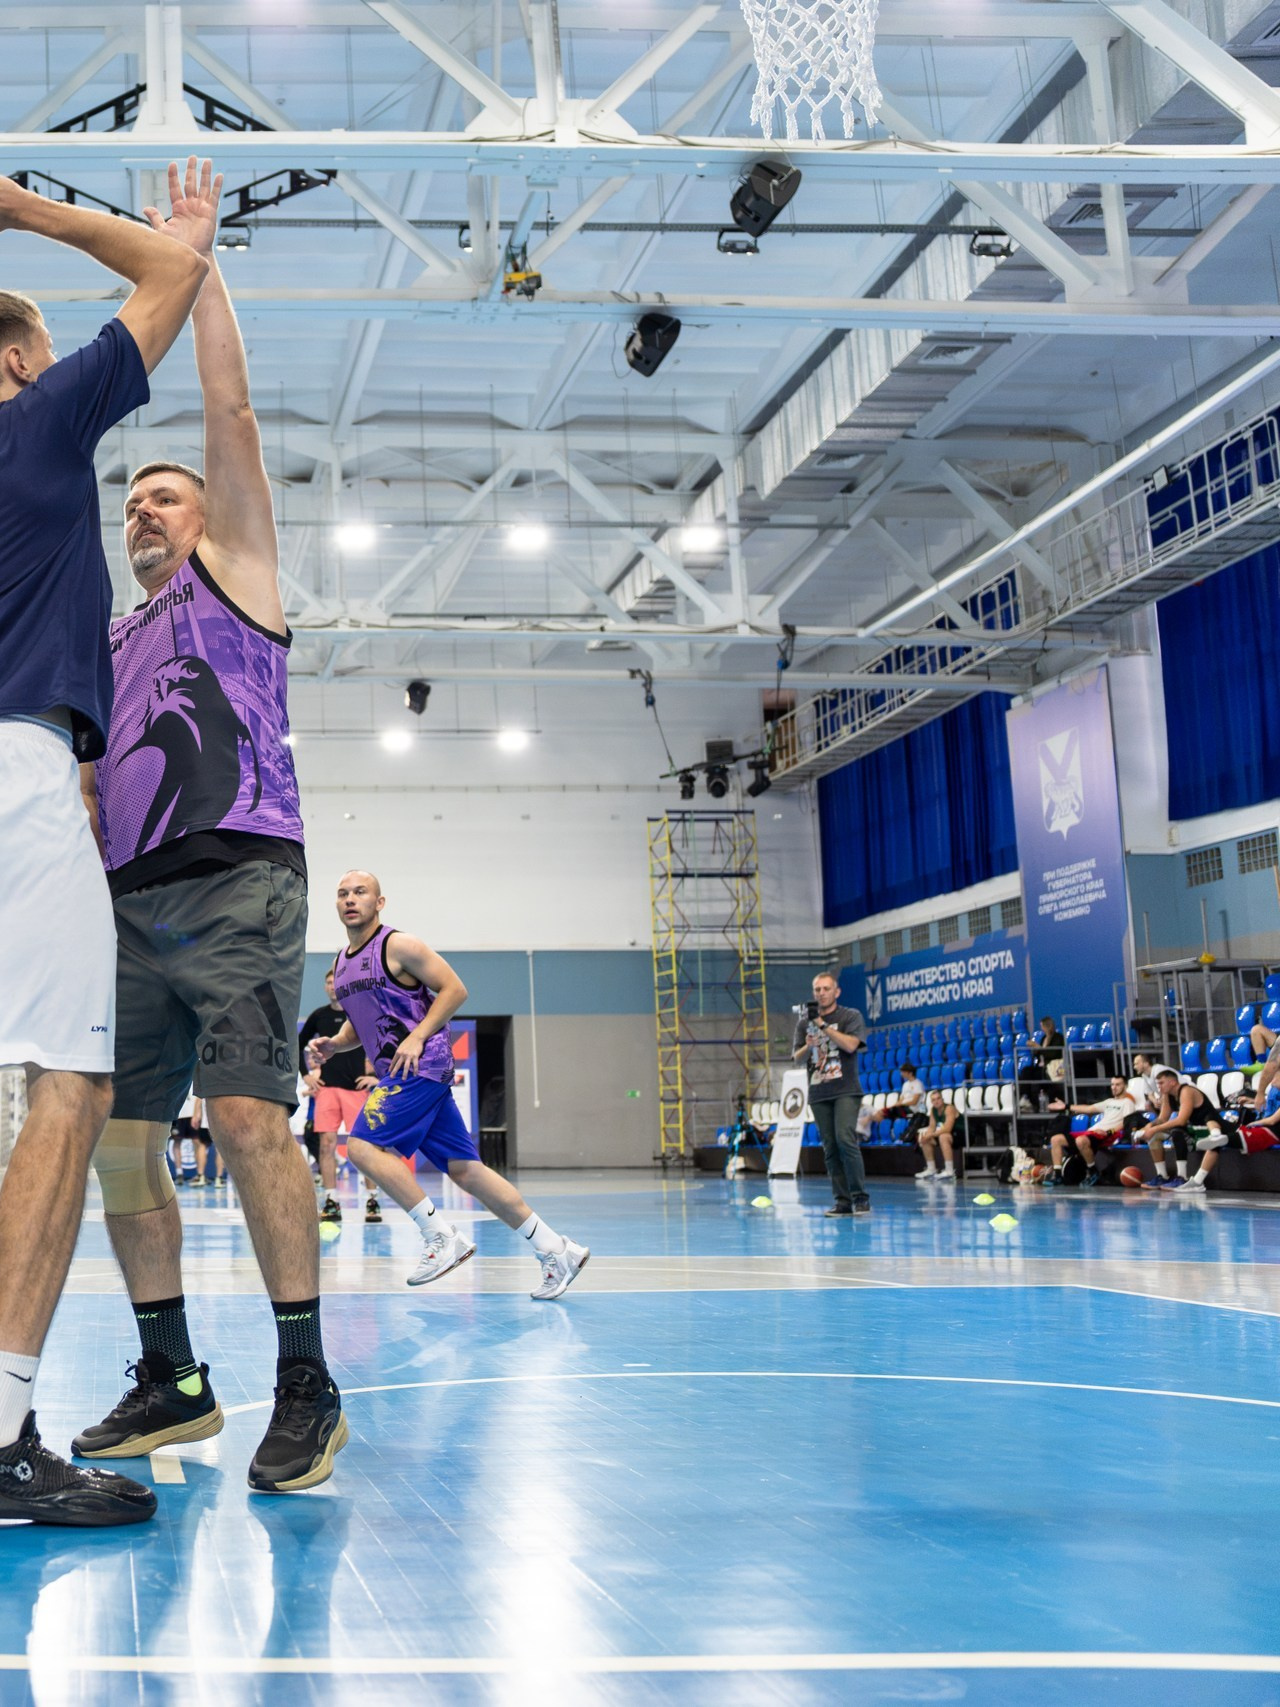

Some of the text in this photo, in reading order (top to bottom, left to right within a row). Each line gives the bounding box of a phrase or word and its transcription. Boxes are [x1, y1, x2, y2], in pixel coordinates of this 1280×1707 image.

[886, 949, 1015, 992] МИНИСТЕРСТВО СПОРТА
[887, 976, 994, 1012] ПРИМОРСКОГО КРАЯ
